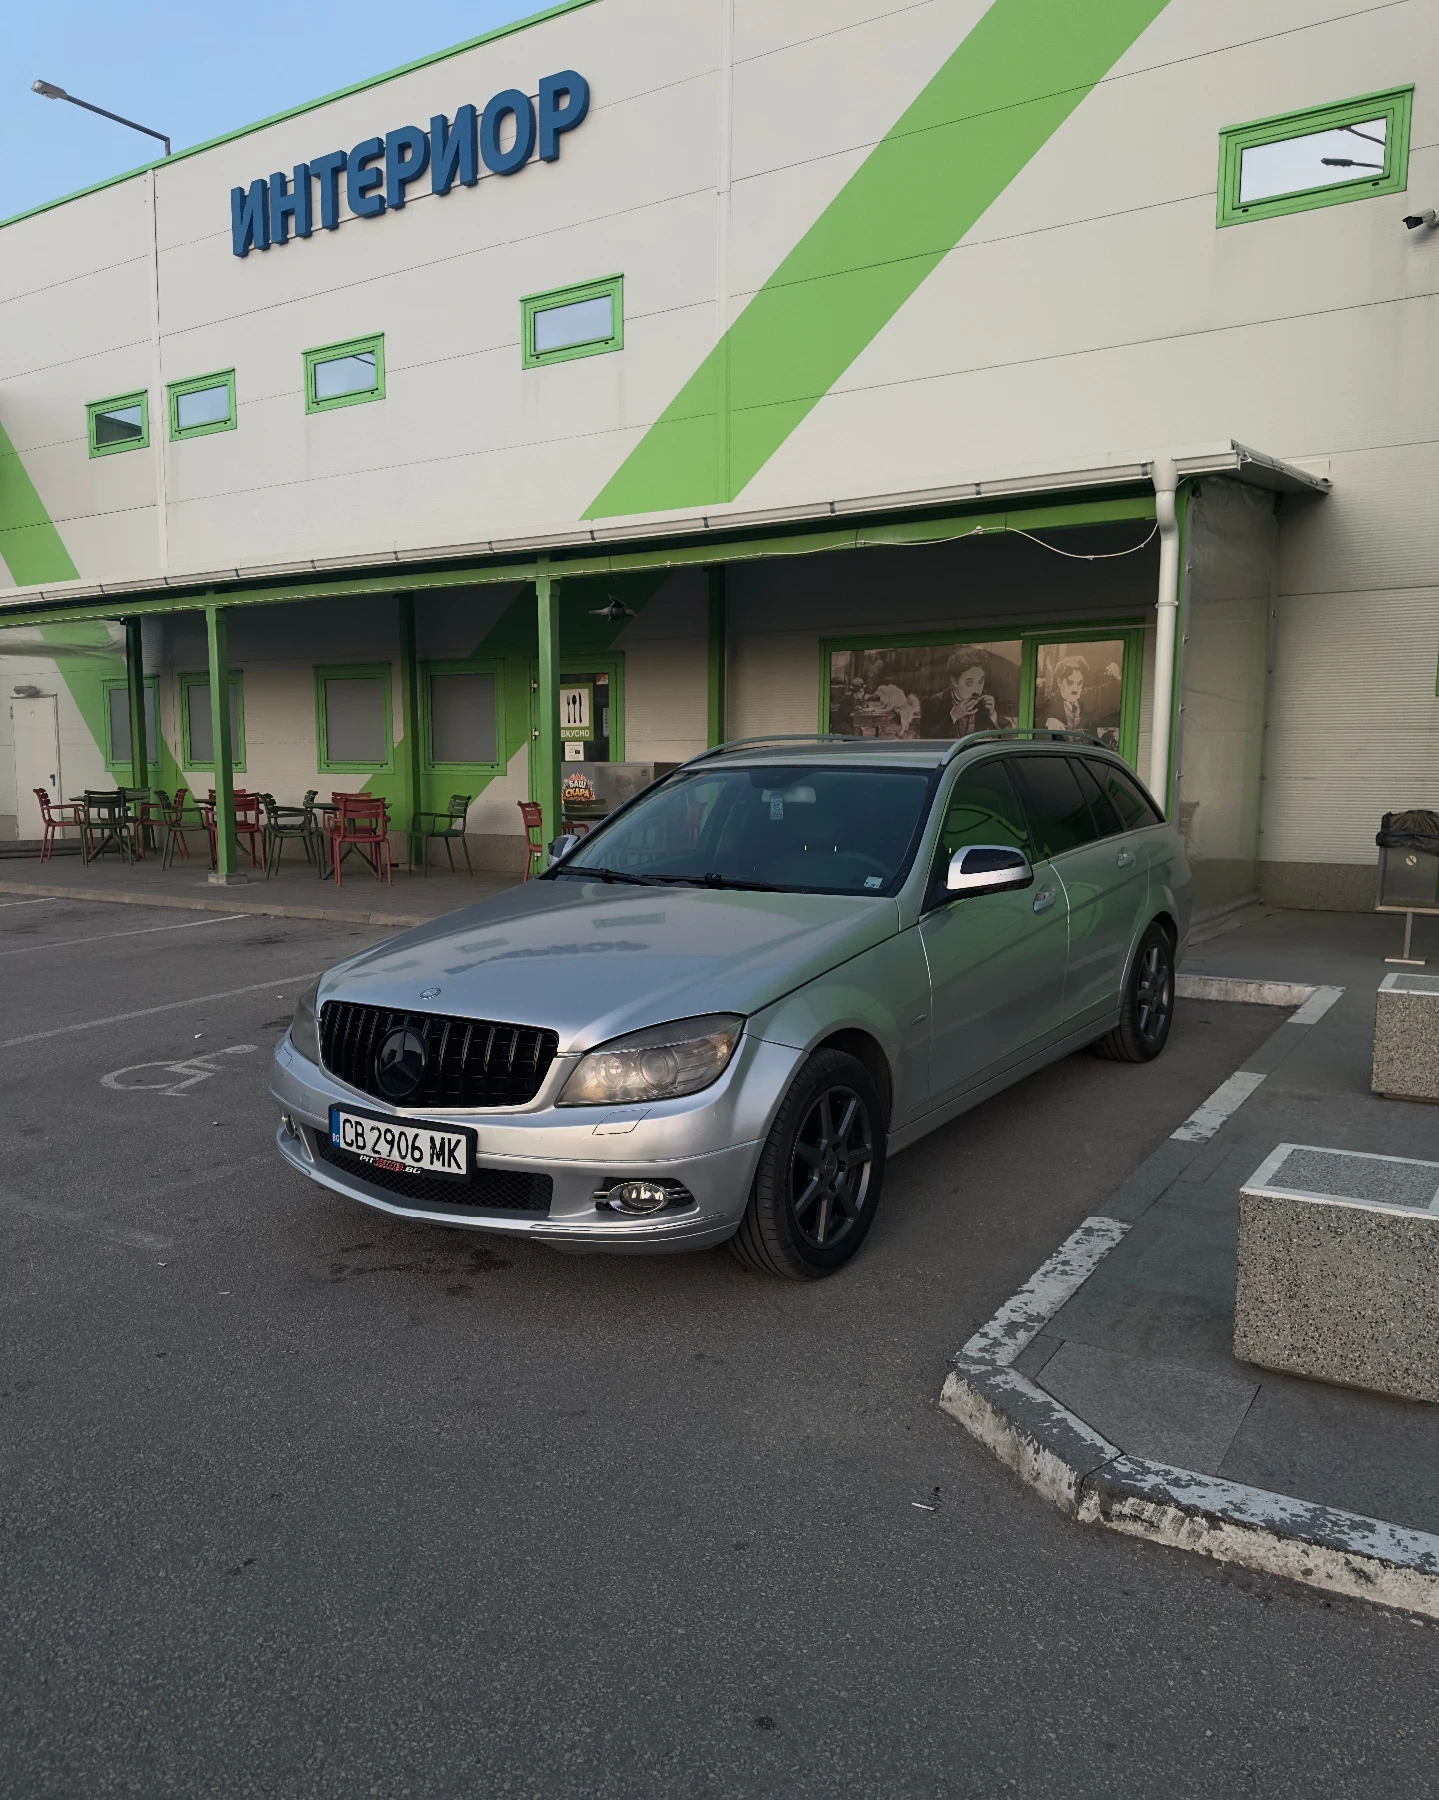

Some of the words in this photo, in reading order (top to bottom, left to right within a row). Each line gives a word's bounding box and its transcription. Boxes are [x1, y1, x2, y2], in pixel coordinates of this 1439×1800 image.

[231, 69, 590, 257] ИНТЕРИОР
[560, 729, 590, 738] ВКУСНО
[569, 780, 587, 789] БАШ
[565, 788, 590, 798] СКАРА
[332, 1133, 340, 1143] BG
[370, 1125, 424, 1163] 2906
[429, 1135, 463, 1170] MK
